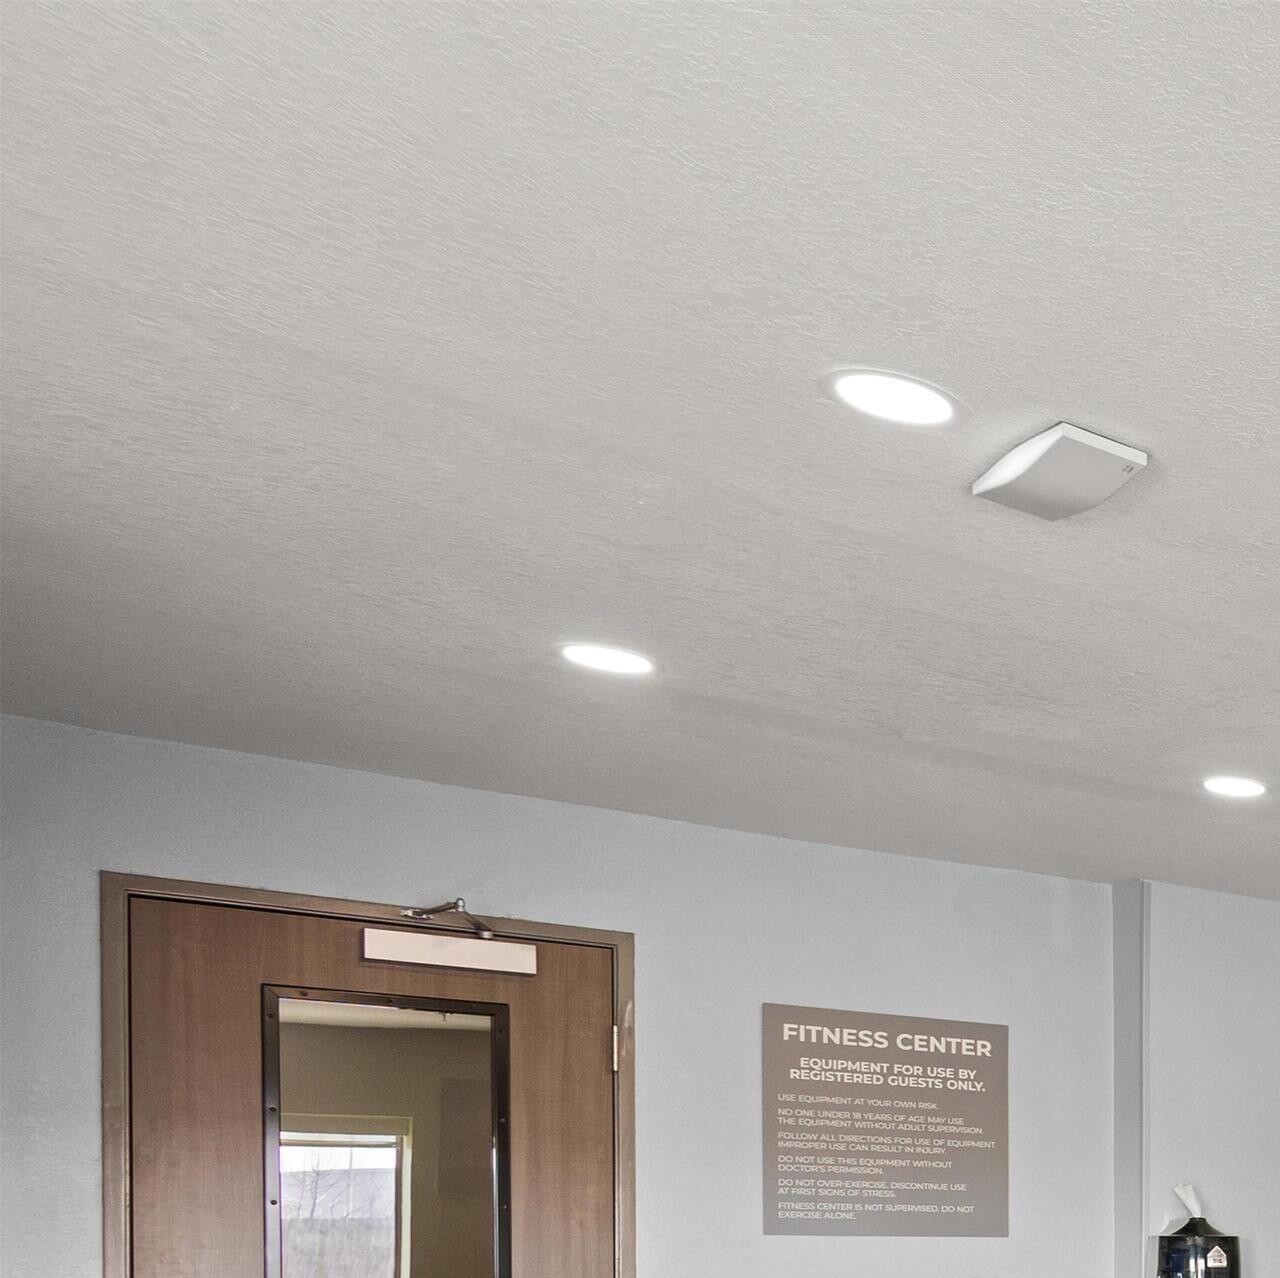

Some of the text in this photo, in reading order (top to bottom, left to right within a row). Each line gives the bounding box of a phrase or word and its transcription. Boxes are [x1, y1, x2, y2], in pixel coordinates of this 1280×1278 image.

[782, 1023, 992, 1057] FITNESS CENTER
[800, 1057, 977, 1080] EQUIPMENT FOR USE BY
[790, 1068, 986, 1092] REGISTERED GUESTS ONLY.
[777, 1094, 939, 1110] USE EQUIPMENT AT YOUR OWN RISK.
[778, 1108, 964, 1125] NO ONE UNDER 18 YEARS OF AGE MAY USE
[777, 1116, 984, 1134] THE EQUIPMENT WITHOUT ADULT SUPERVISION.
[777, 1131, 818, 1140] FOLLOW
[819, 1133, 837, 1141] ALL
[839, 1134, 892, 1143] DIRECTIONS
[894, 1136, 913, 1144] FOR
[914, 1138, 932, 1146] USE
[932, 1138, 945, 1146] OF
[777, 1141, 827, 1149] IMPROPER
[828, 1142, 847, 1150] USE
[848, 1143, 868, 1151] CAN
[871, 1144, 903, 1153] RESULT
[778, 1155, 953, 1168] DO NOT USE THIS EQUIPMENT WITHOUT
[777, 1163, 884, 1175] DOCTOR'S PERMISSION.
[778, 1178, 793, 1186] DO
[795, 1179, 815, 1187] NOT
[890, 1181, 950, 1191] DISCONTINUE
[950, 1183, 967, 1191] USE
[777, 1187, 896, 1198] AT FIRST SIGNS OF STRESS.
[778, 1201, 815, 1210] FITNESS
[817, 1202, 853, 1211] CENTER
[854, 1203, 863, 1211] IS
[865, 1203, 883, 1211] NOT
[941, 1205, 955, 1213] DO
[957, 1205, 975, 1213] NOT
[778, 1210, 822, 1219] EXERCISE
